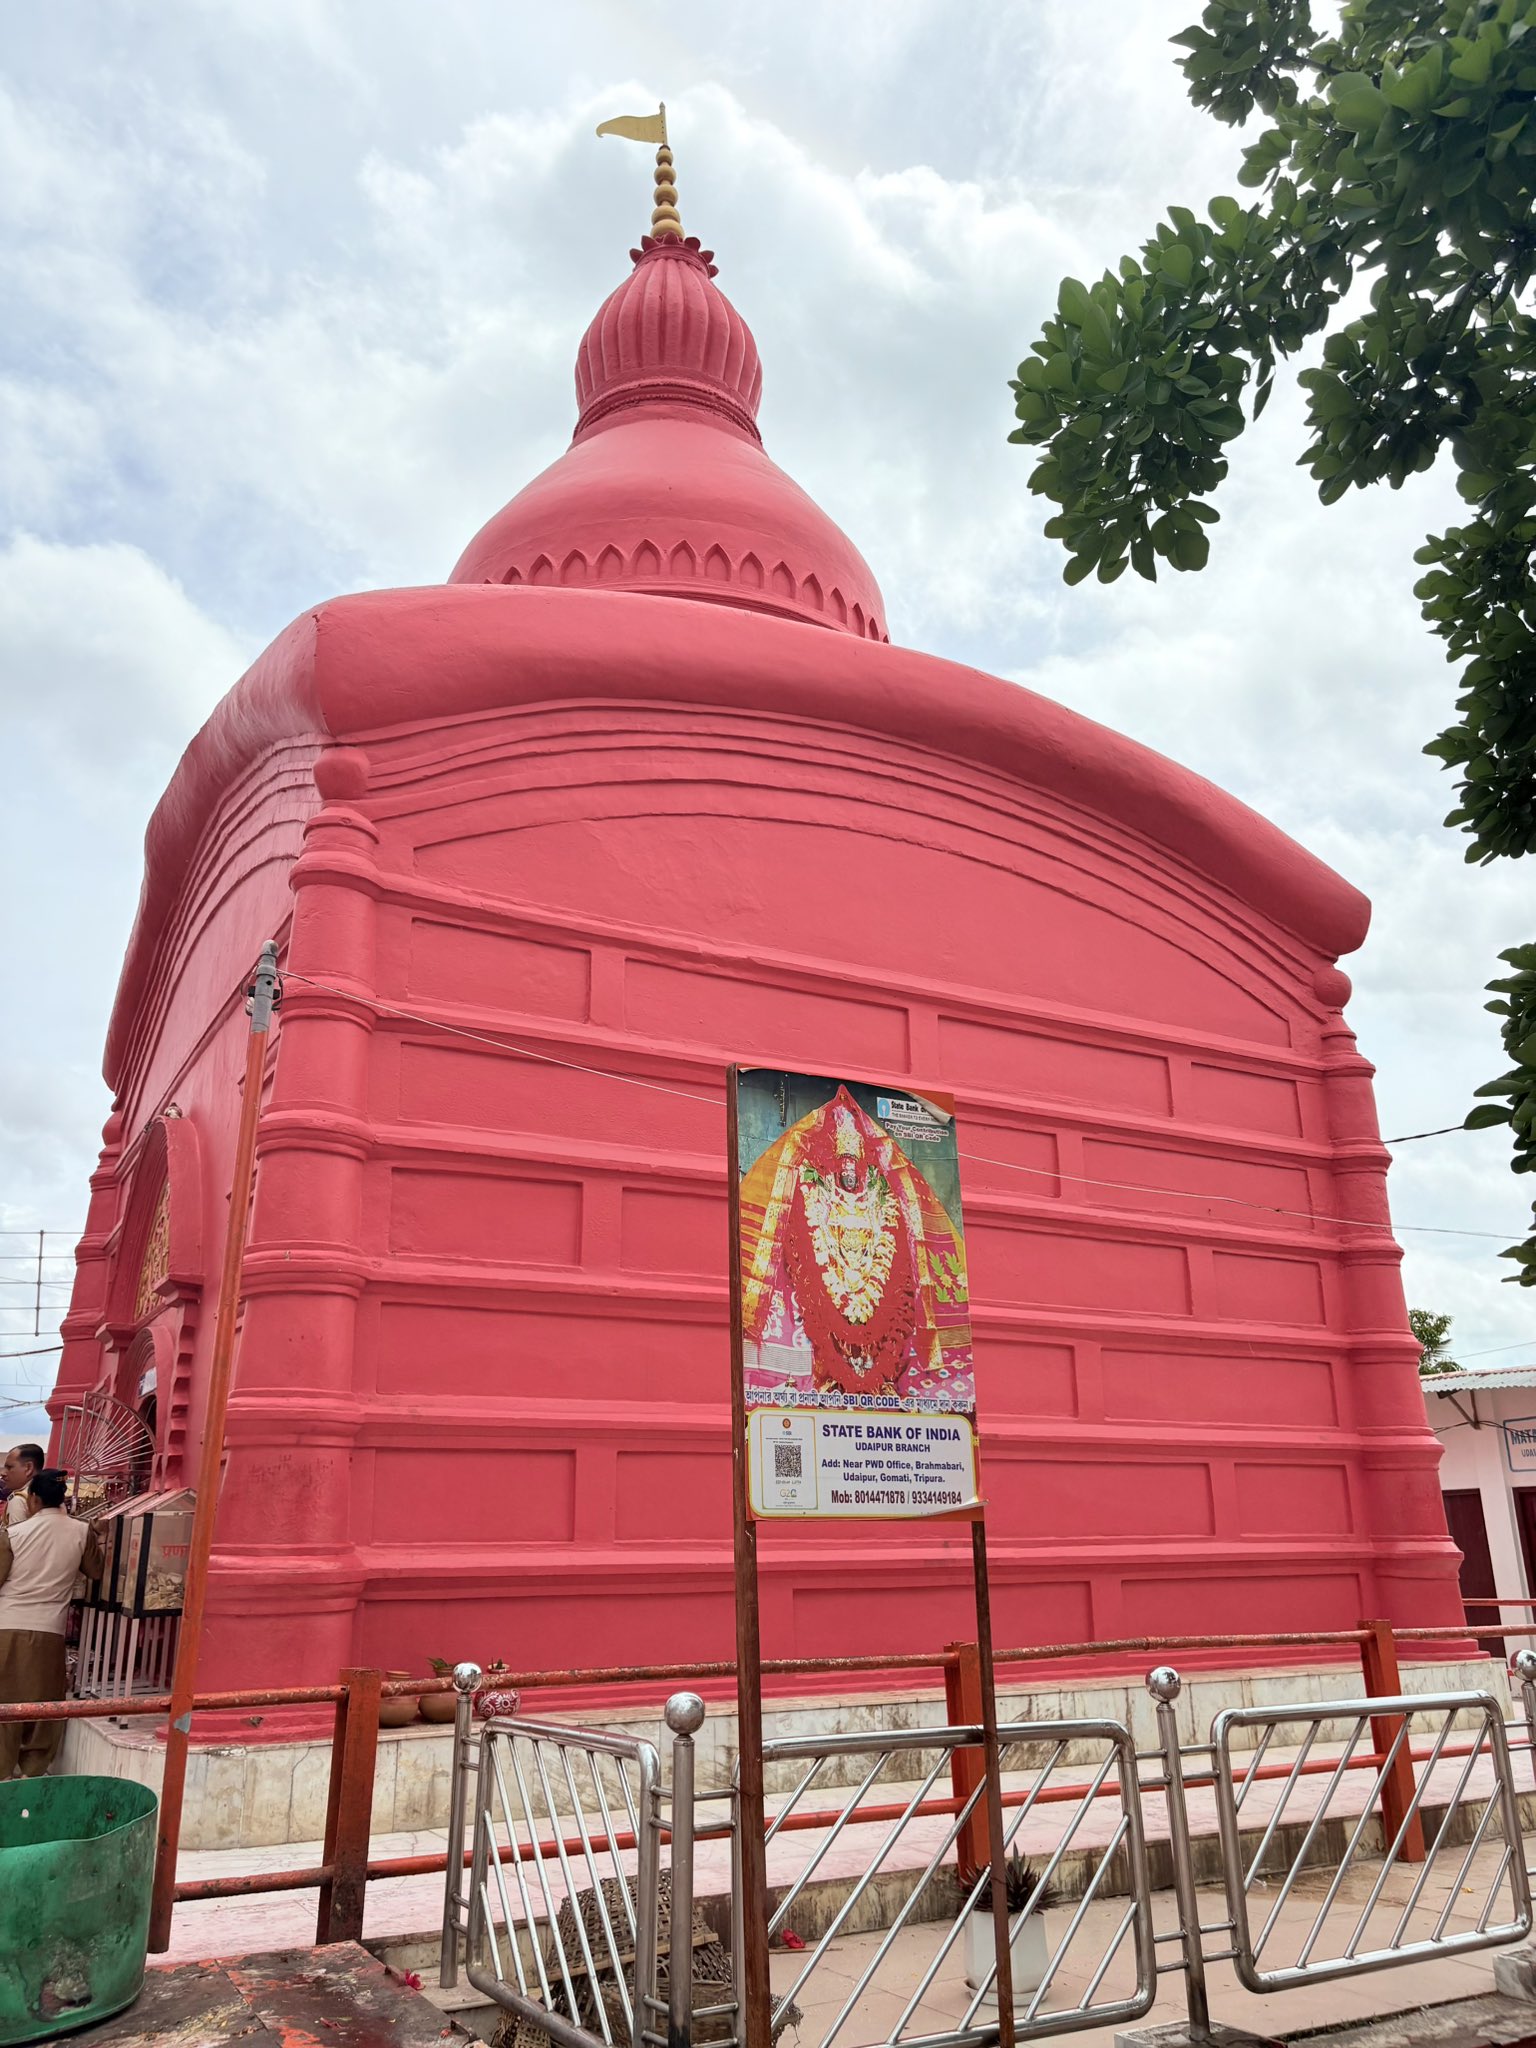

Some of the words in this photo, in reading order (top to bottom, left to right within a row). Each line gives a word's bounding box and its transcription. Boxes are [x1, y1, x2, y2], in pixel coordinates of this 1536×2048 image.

[891, 1100, 904, 1110] State
[906, 1103, 919, 1112] Bank
[886, 1122, 897, 1131] Pay
[912, 1126, 948, 1136] Contribution
[843, 1395, 858, 1406] SBI
[861, 1395, 873, 1407] QR
[876, 1396, 900, 1407] CODE
[822, 1424, 862, 1438] STATE
[867, 1425, 902, 1439] BANK
[906, 1428, 922, 1440] OF
[926, 1428, 961, 1441] INDIA
[855, 1442, 894, 1452] UDAIPUR
[896, 1442, 931, 1453] BRANCH
[821, 1459, 841, 1468] Add:
[843, 1459, 863, 1469] Near
[865, 1459, 884, 1469] PWD
[886, 1460, 914, 1471] Office,
[915, 1460, 965, 1472] Brahmabari,
[843, 1473, 879, 1484] Udaipur,
[880, 1473, 912, 1484] Gomati,
[914, 1474, 946, 1483] Tripura.
[831, 1490, 853, 1504] Mob:
[854, 1490, 906, 1504] 8014471878
[912, 1490, 962, 1504] 9334149184
